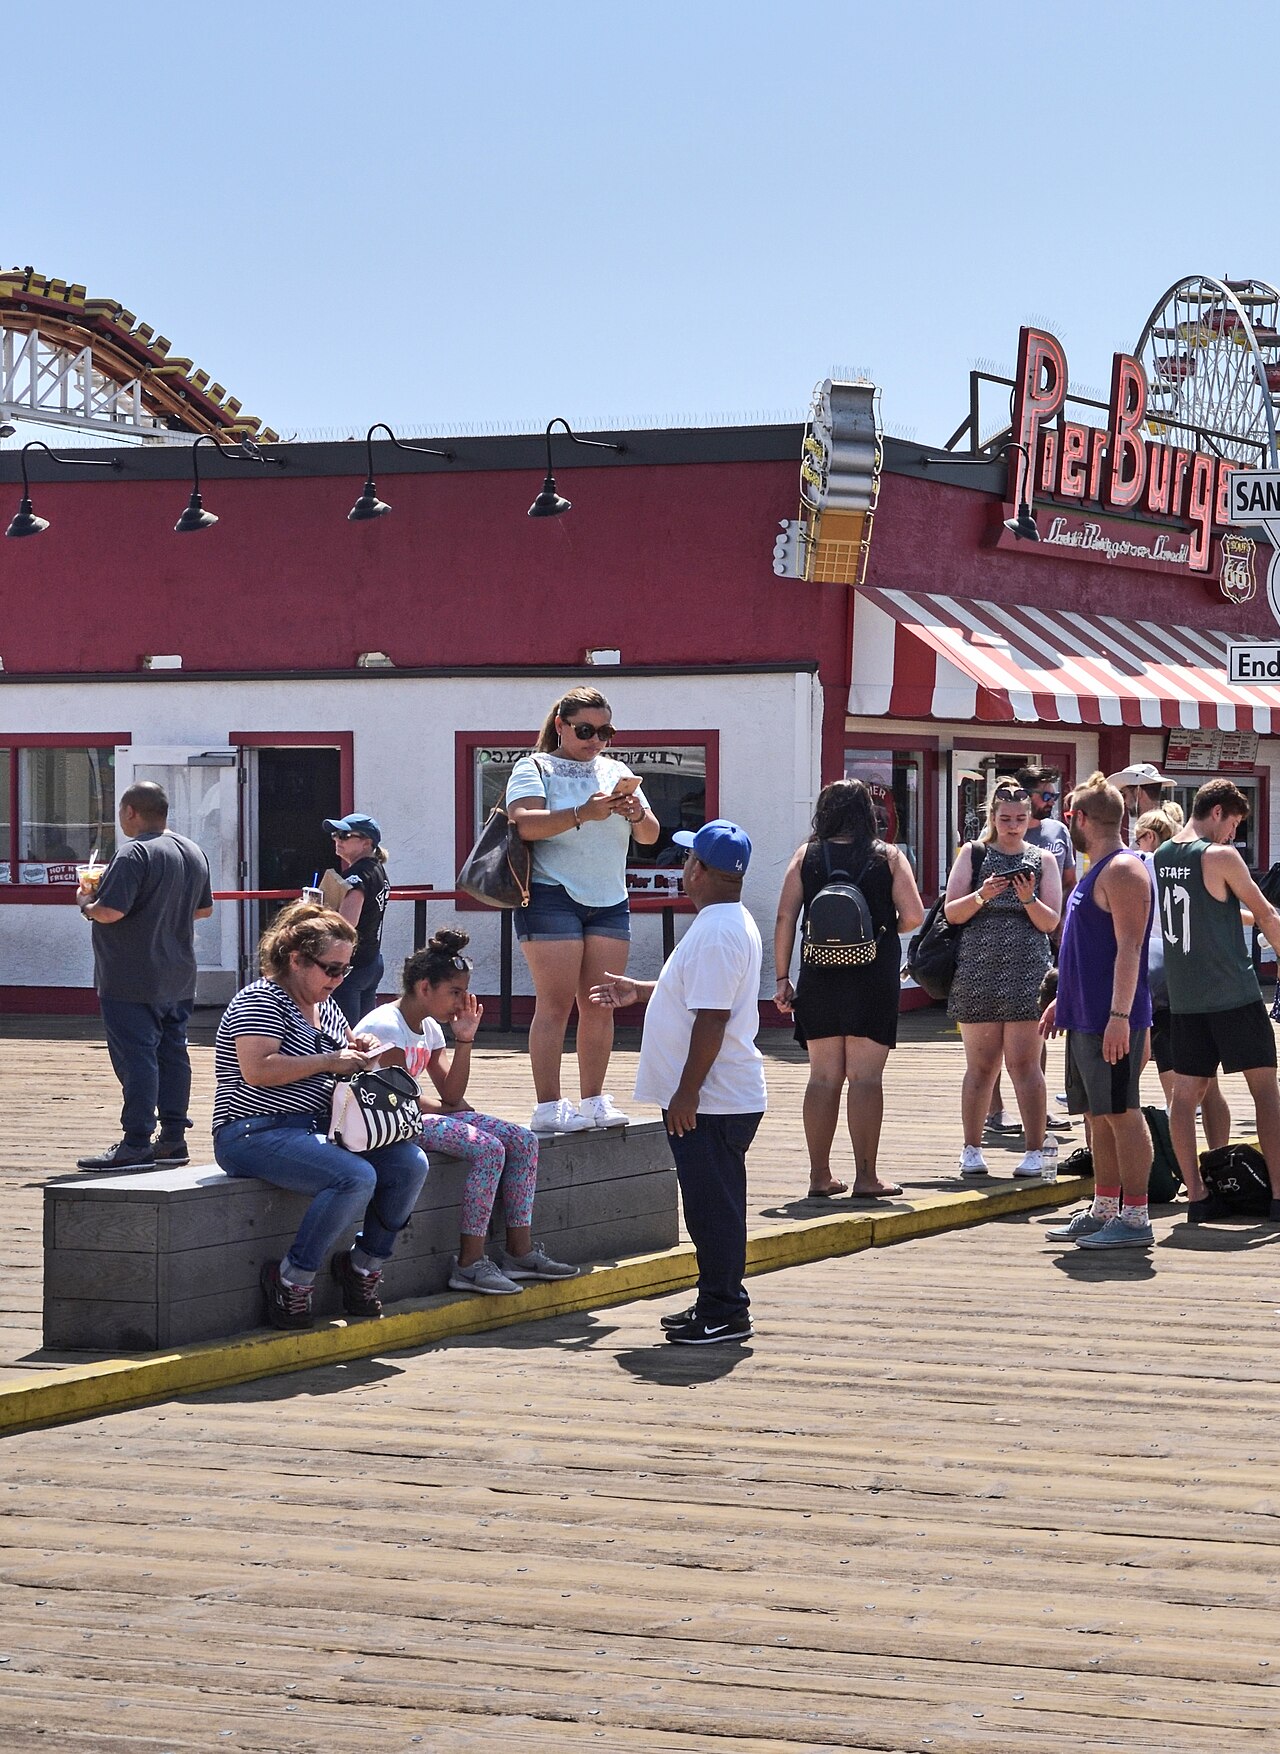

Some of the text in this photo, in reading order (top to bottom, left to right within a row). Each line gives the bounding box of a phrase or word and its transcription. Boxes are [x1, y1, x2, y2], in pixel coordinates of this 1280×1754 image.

[1012, 326, 1258, 572] PierBurge
[867, 785, 886, 801] IER
[49, 873, 76, 883] FRESH
[625, 873, 652, 888] Pier
[1159, 866, 1191, 880] STAFF
[1163, 883, 1191, 956] 17
